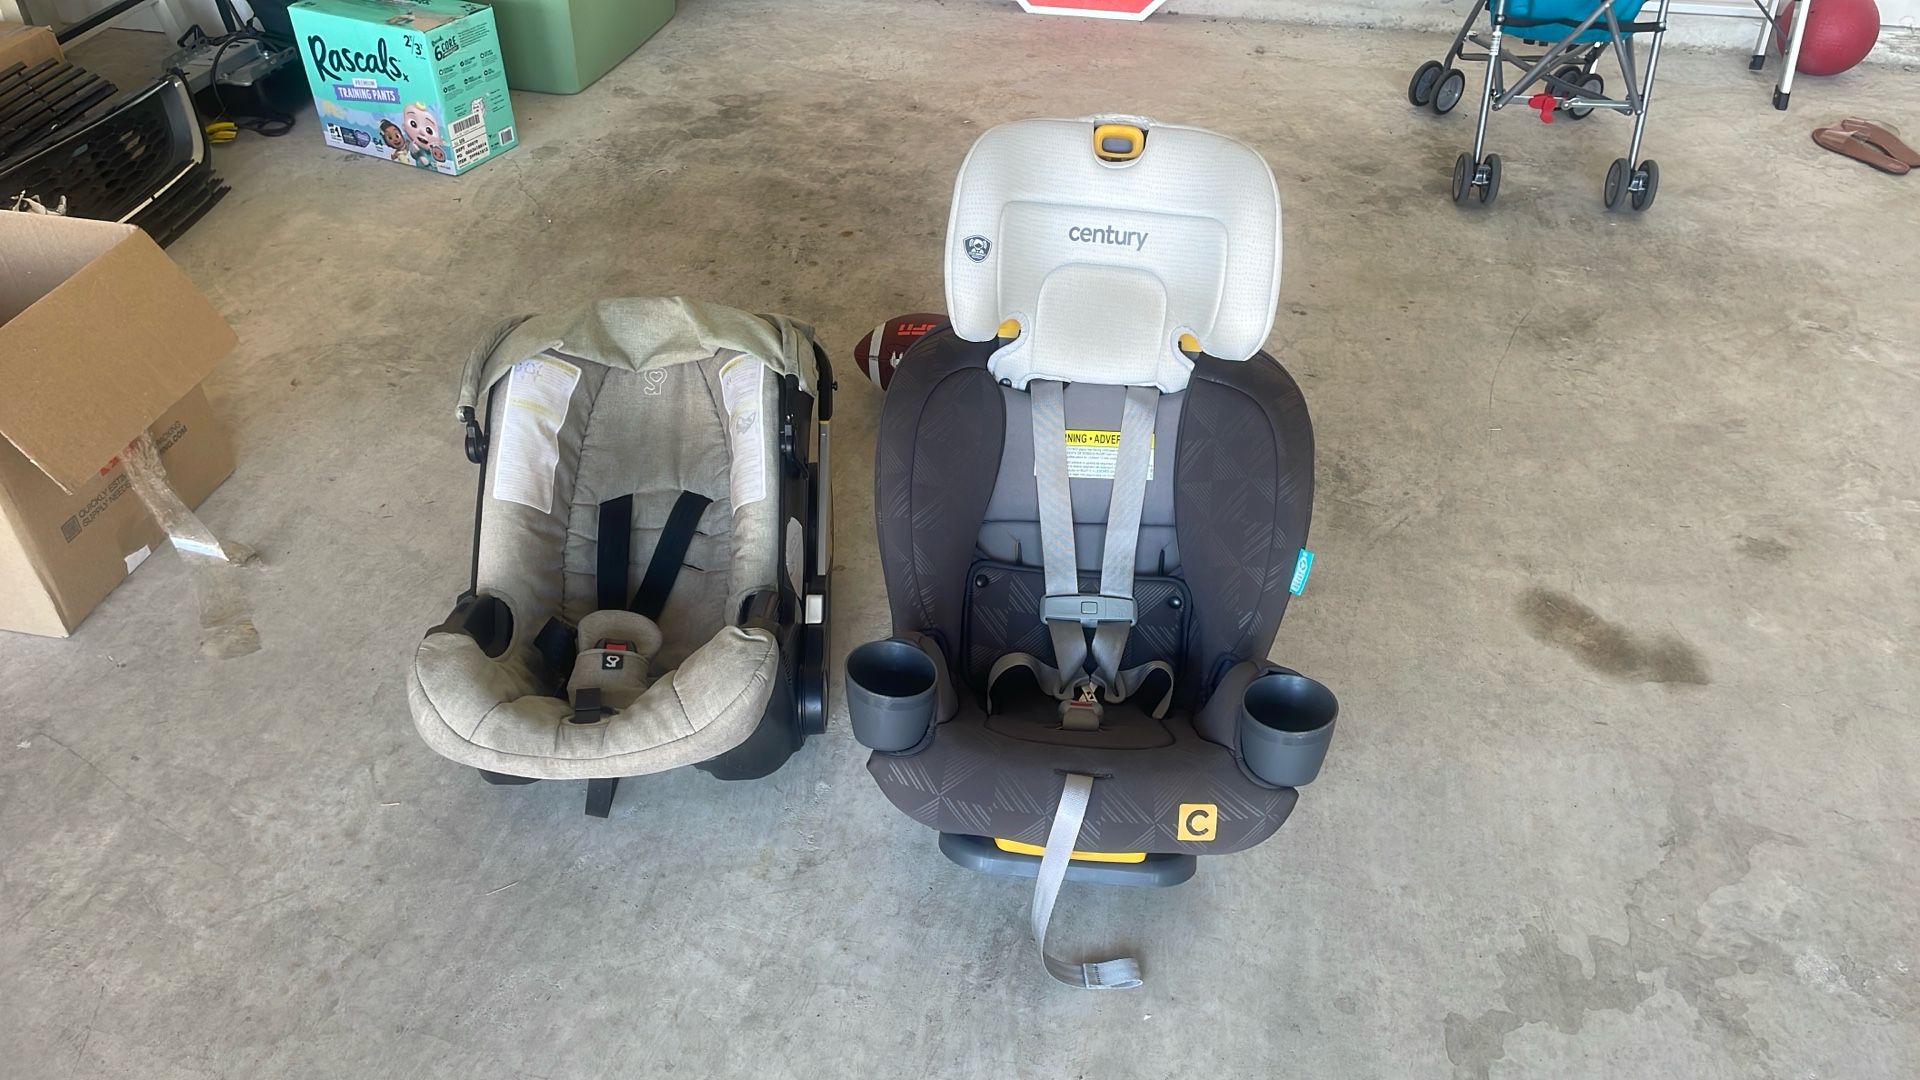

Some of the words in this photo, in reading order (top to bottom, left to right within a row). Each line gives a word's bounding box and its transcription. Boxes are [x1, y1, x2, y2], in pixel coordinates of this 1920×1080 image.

[307, 34, 402, 82] Rascals
[338, 87, 372, 100] TRAINING
[372, 89, 396, 102] PANTS
[1068, 225, 1149, 251] century
[1065, 433, 1087, 444] NING
[79, 488, 108, 518] QUICKLY
[1186, 809, 1209, 836] C
